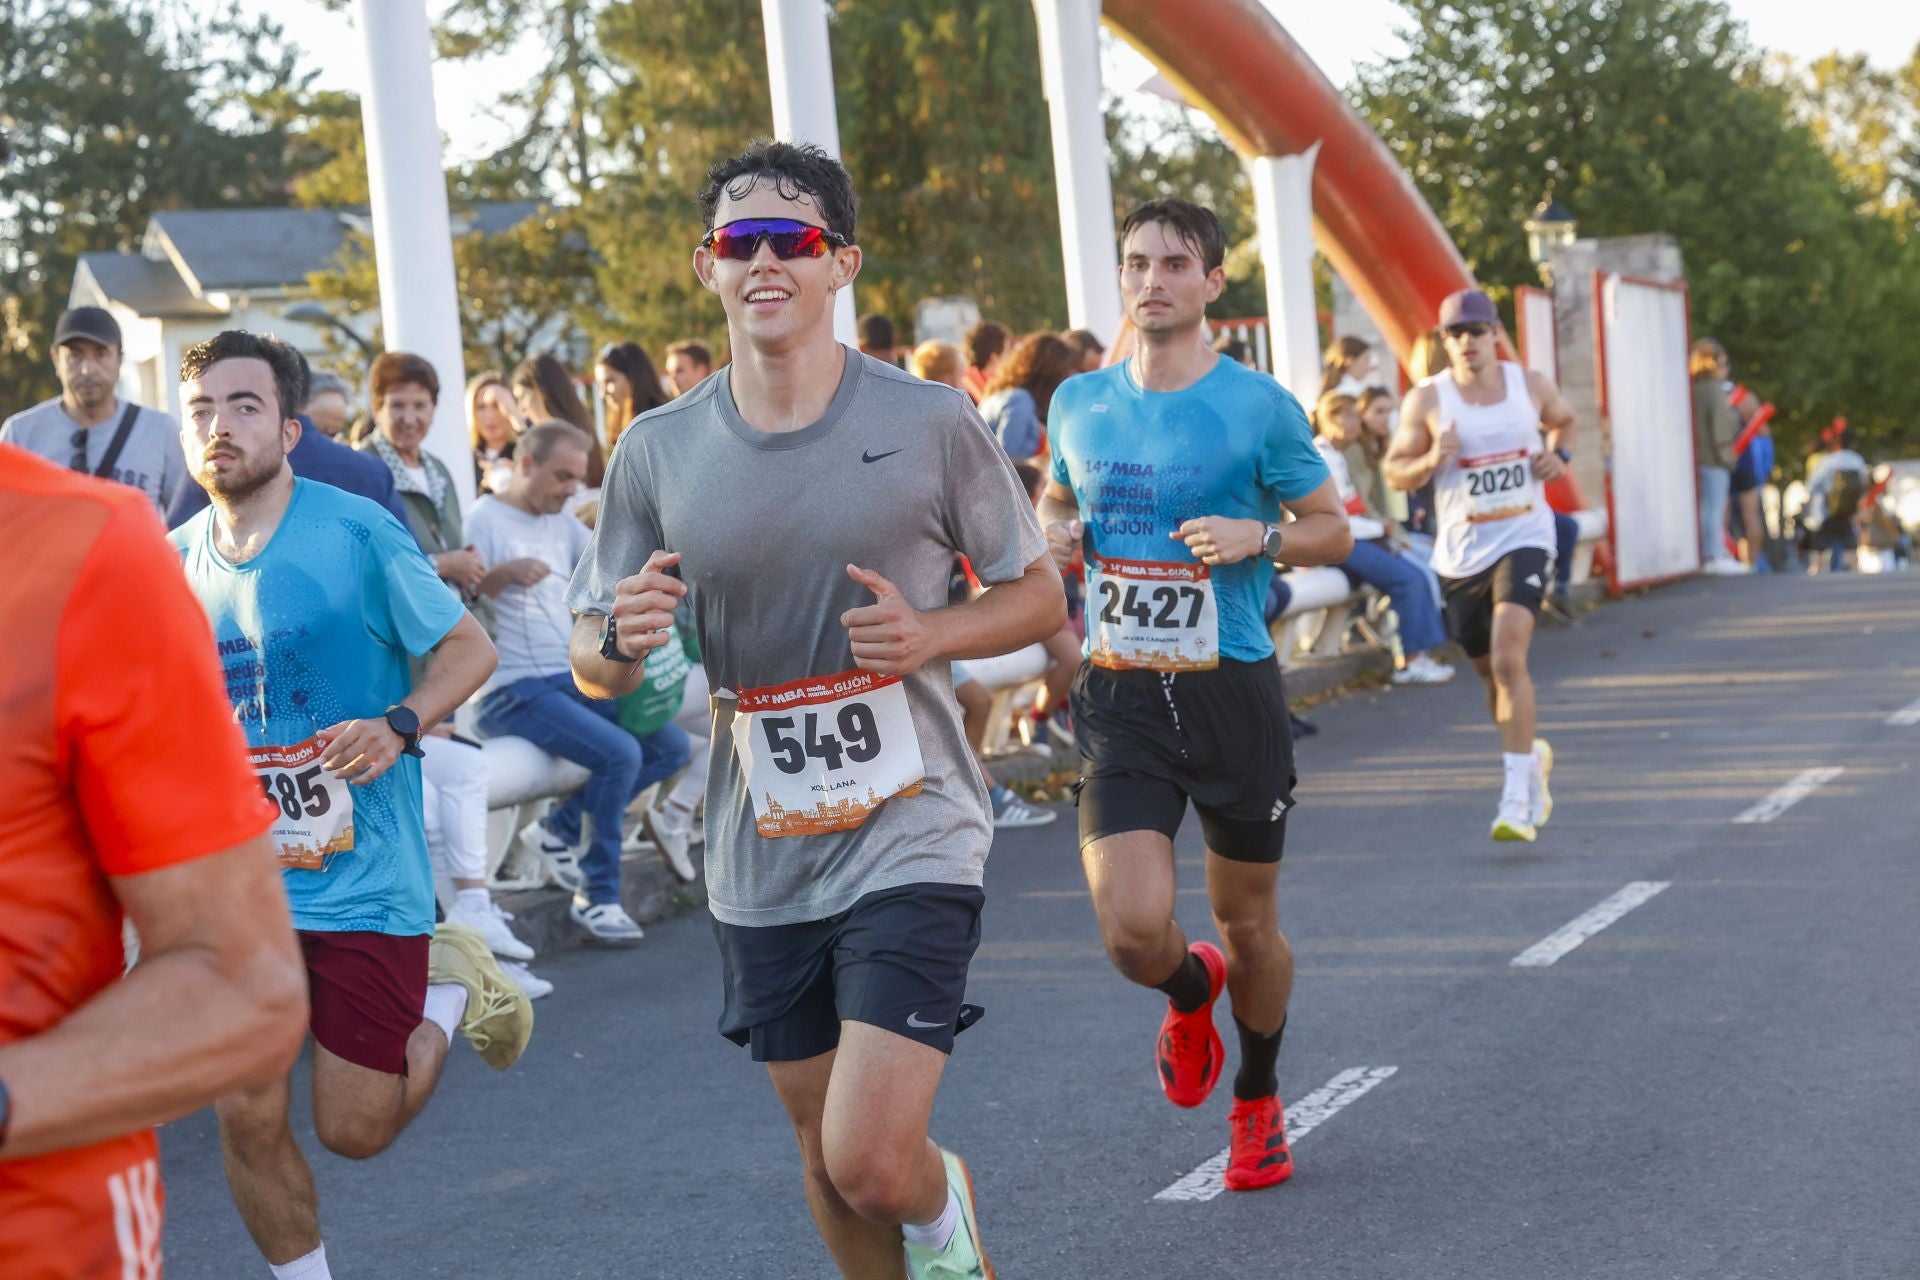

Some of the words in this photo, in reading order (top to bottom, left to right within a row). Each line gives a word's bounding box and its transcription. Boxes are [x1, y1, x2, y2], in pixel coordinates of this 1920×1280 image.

[1110, 462, 1153, 477] MBA
[1468, 464, 1524, 496] 2020
[1100, 483, 1153, 499] media
[1101, 516, 1154, 536] GIJÓN
[1122, 564, 1147, 575] MBA
[1167, 567, 1195, 578] GIJÓN
[1099, 580, 1205, 628] 2427
[218, 637, 259, 656] MBA
[772, 688, 807, 705] MBA
[806, 684, 826, 692] media
[833, 673, 872, 693] GIJÓN
[807, 688, 835, 698] maratón
[761, 702, 882, 775] 549
[286, 745, 314, 763] GIJÓN
[830, 779, 857, 791] LANA
